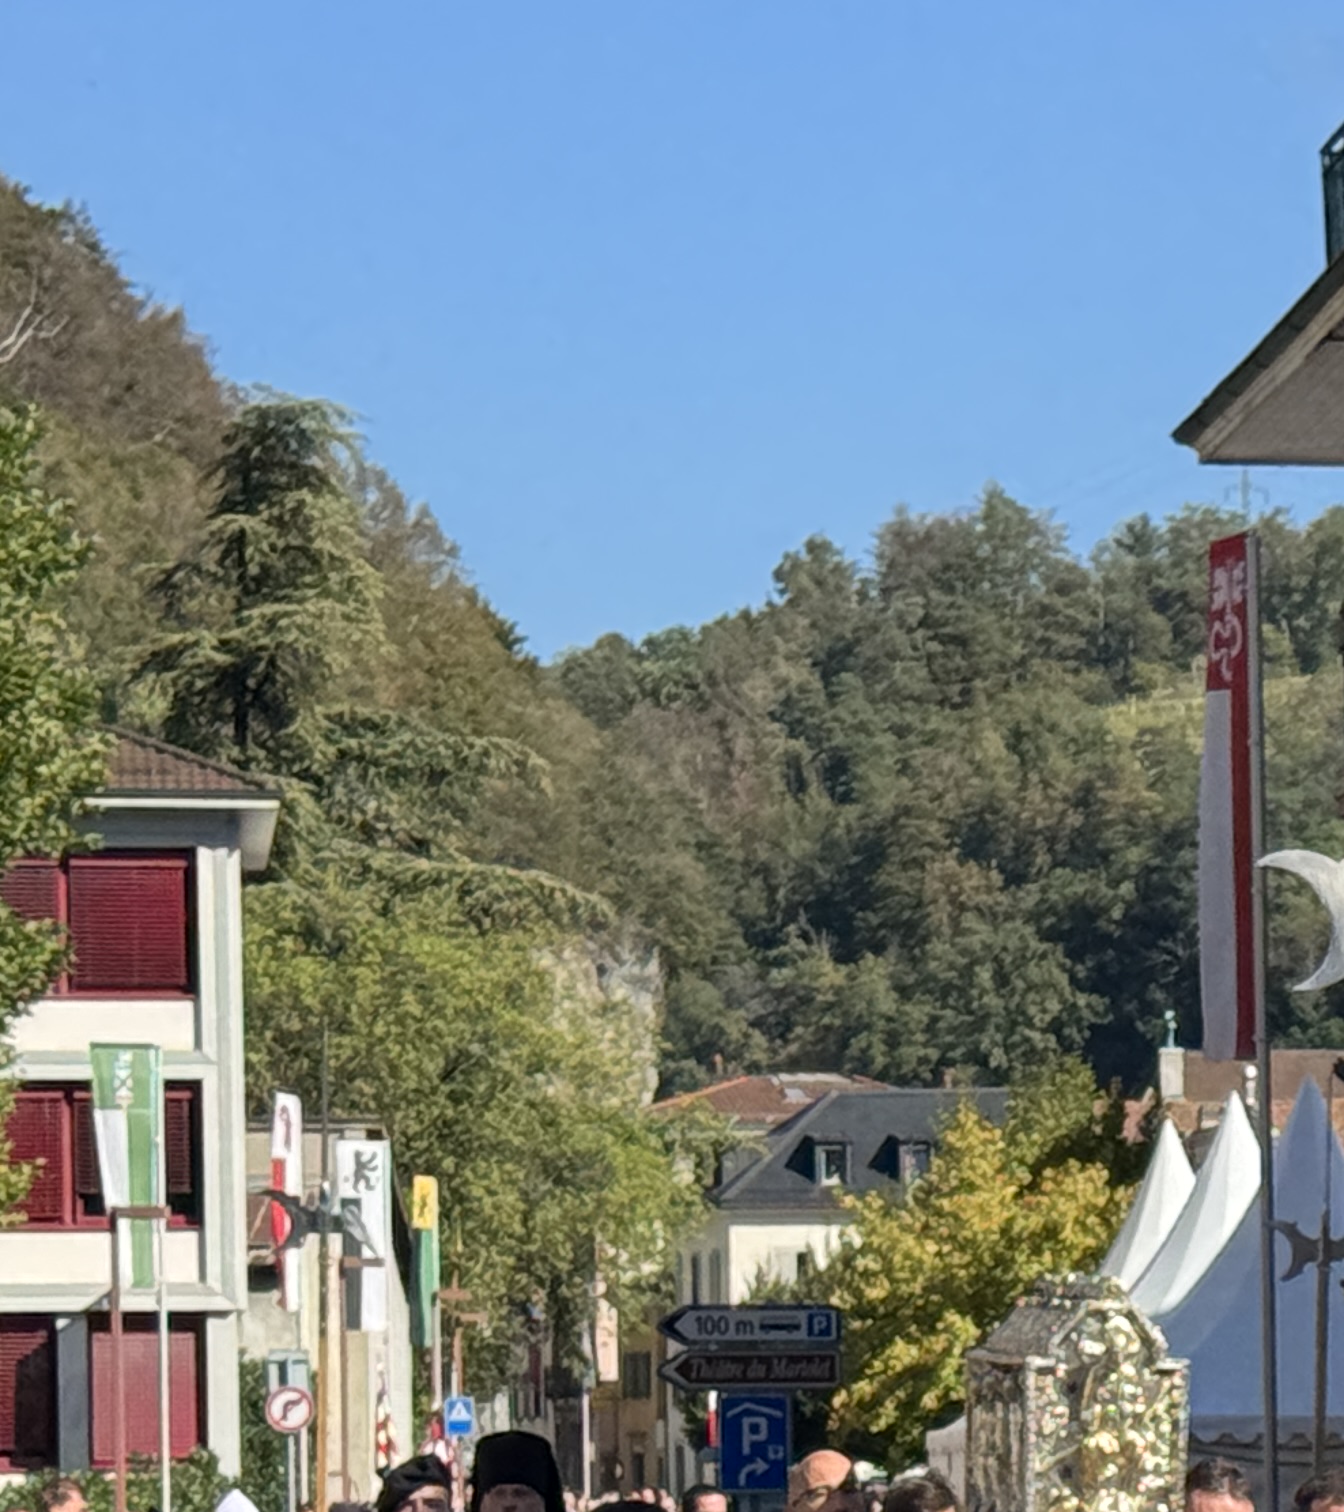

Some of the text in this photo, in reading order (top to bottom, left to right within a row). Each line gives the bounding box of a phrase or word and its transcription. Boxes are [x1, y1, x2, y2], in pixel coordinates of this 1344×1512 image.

[694, 1315, 828, 1336] 100 m P
[746, 1357, 767, 1378] du
[742, 1416, 768, 1456] P
